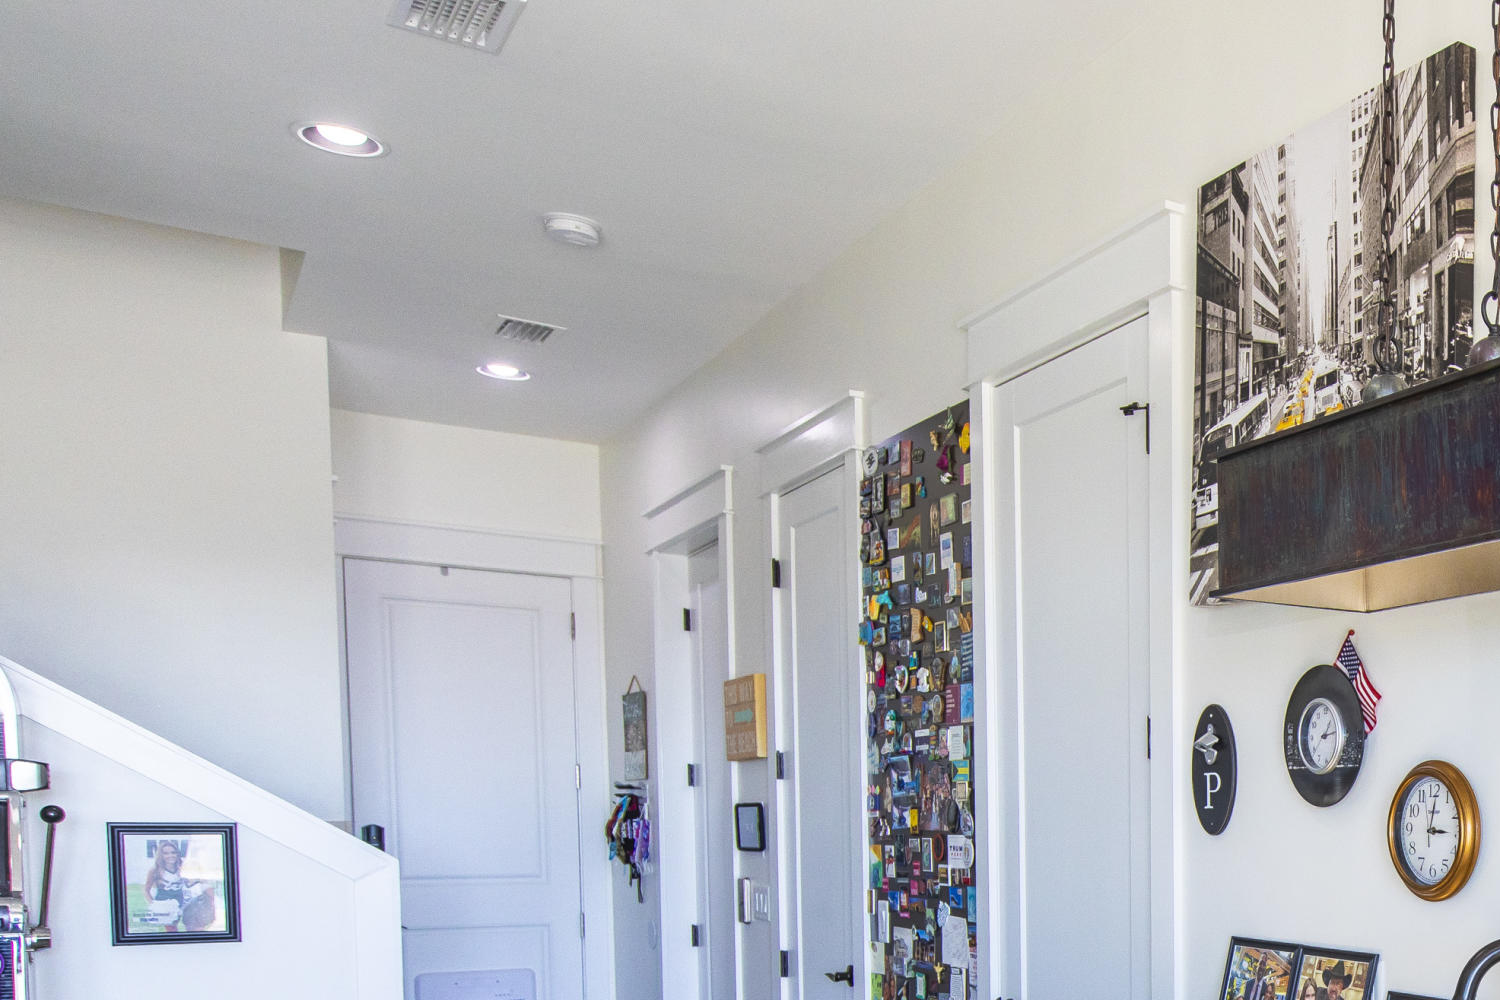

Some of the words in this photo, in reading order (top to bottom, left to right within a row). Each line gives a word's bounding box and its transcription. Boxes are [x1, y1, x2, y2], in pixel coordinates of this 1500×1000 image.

[1203, 772, 1221, 809] P
[1418, 789, 1425, 803] 11
[1428, 783, 1441, 798] 12
[1409, 803, 1420, 818] 10
[1405, 822, 1413, 836] 9
[1408, 841, 1416, 855] 8
[1417, 857, 1425, 871] 7
[1429, 864, 1437, 878] 6
[1440, 859, 1449, 873] 5
